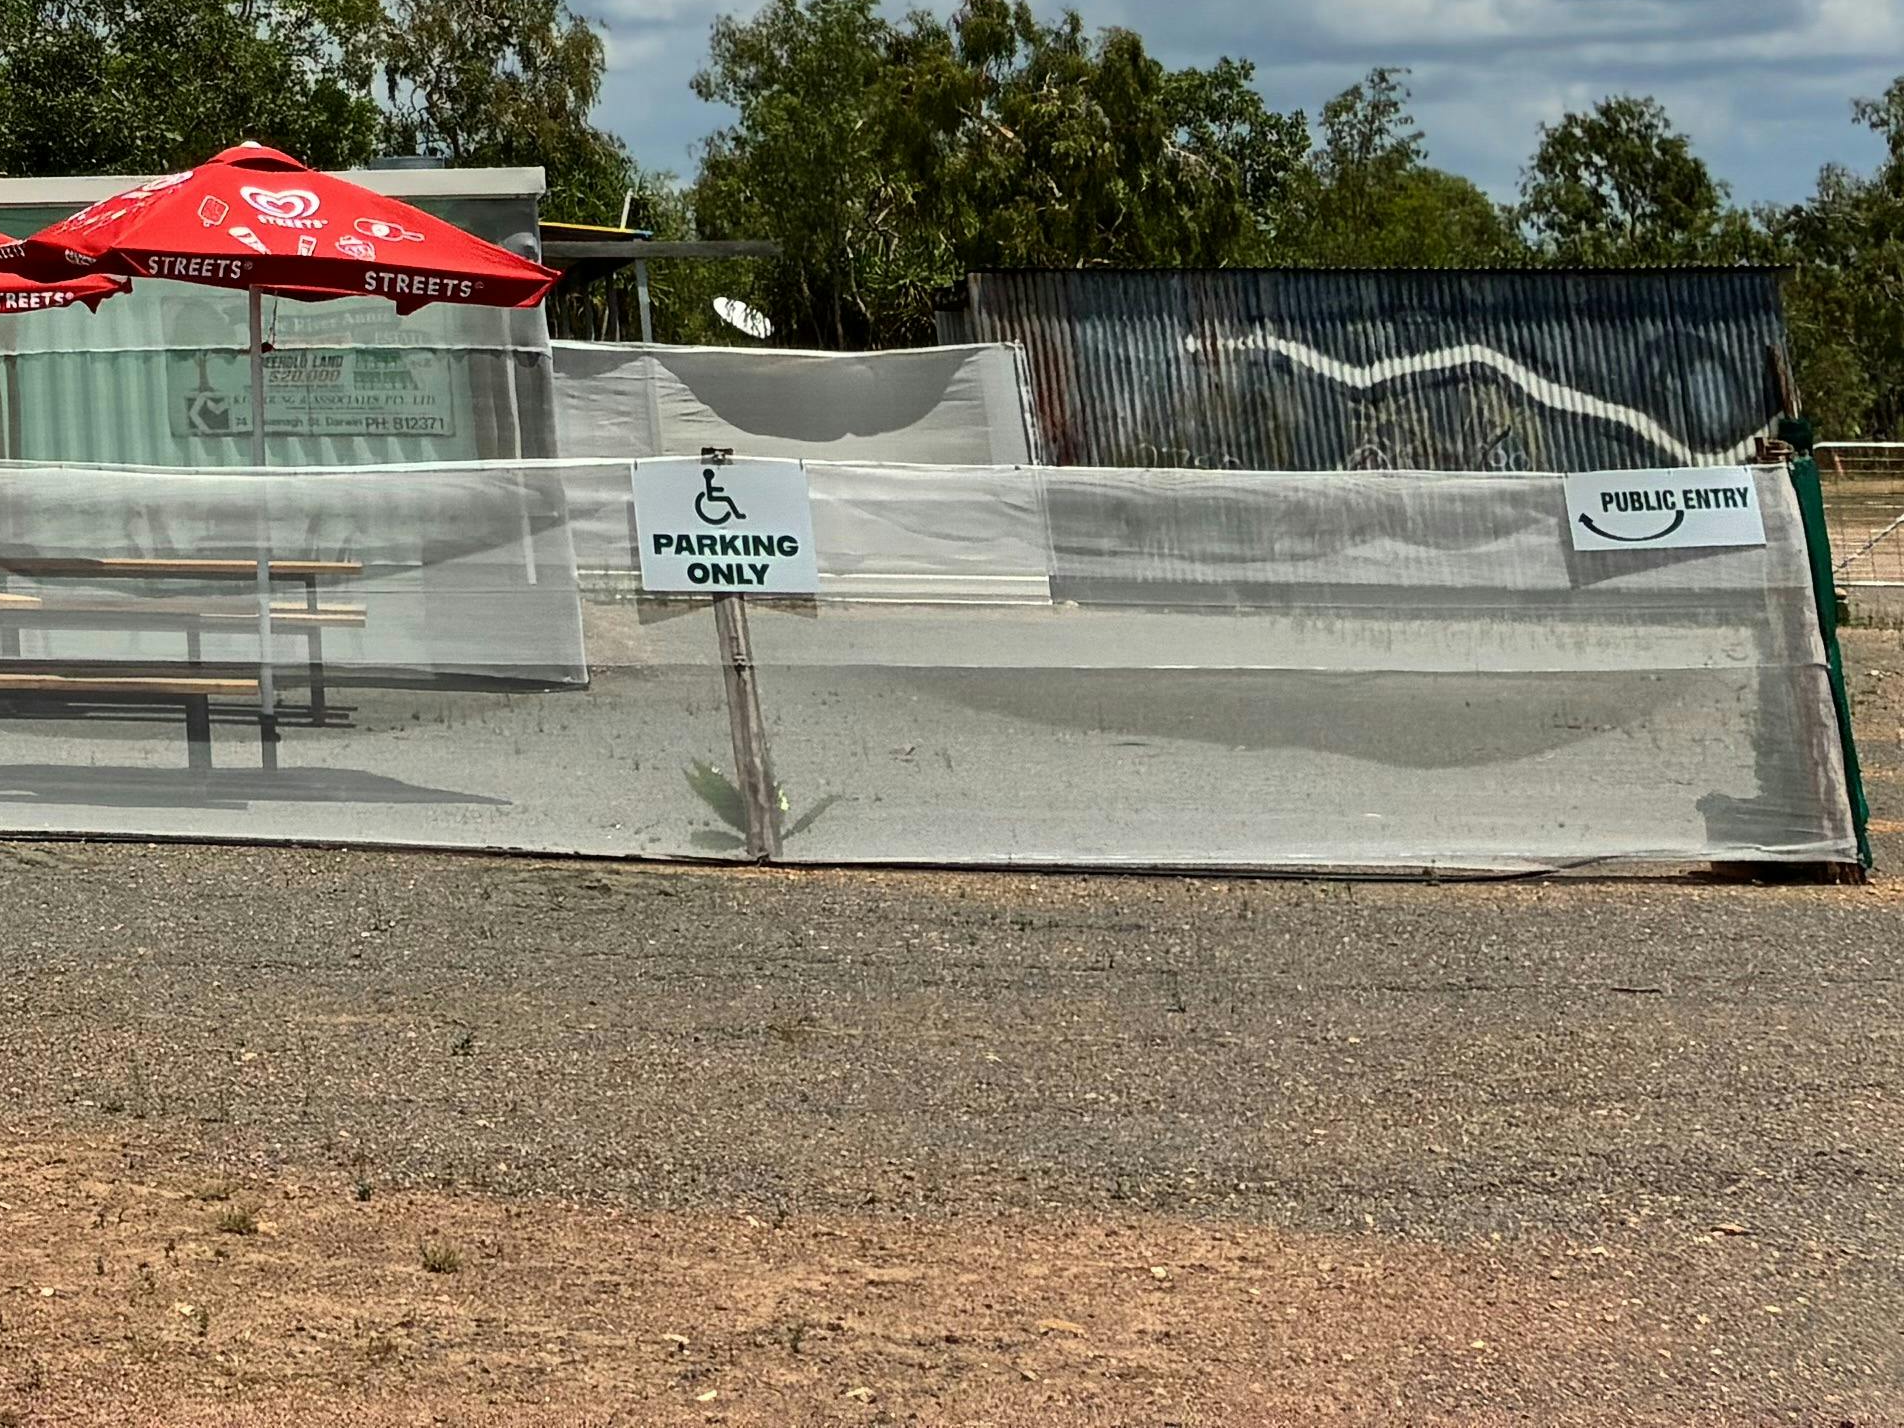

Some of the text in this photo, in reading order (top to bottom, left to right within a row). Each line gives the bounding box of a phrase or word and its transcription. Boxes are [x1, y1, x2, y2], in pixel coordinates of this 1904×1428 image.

[257, 215, 323, 229] STREETS
[148, 256, 242, 278] STREETS
[364, 271, 473, 297] STREETS
[262, 355, 344, 368] EEHOLD LAND
[392, 416, 445, 431] 812371
[1600, 487, 1749, 513] PUBLIC ENTRY
[653, 534, 799, 557] PARKING
[687, 562, 770, 585] ONLY
